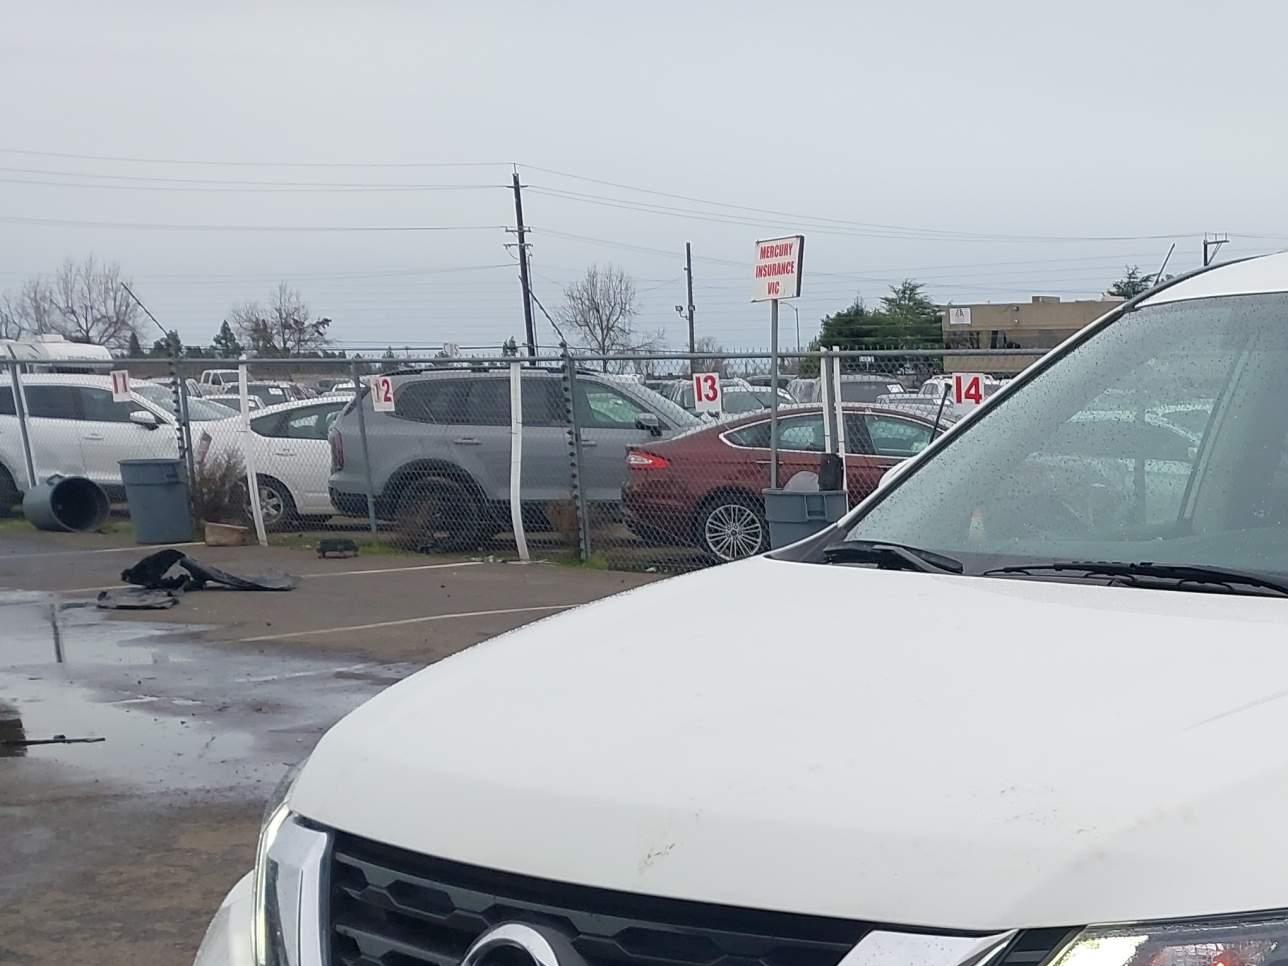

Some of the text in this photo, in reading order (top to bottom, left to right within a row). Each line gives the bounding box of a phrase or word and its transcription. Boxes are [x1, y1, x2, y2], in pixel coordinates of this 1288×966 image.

[760, 243, 793, 260] MERCURY
[755, 261, 795, 279] INSURANCE
[767, 281, 780, 295] VIC
[112, 373, 128, 394] 11
[374, 379, 393, 402] 12
[695, 375, 718, 402] 13
[955, 376, 983, 404] 14
